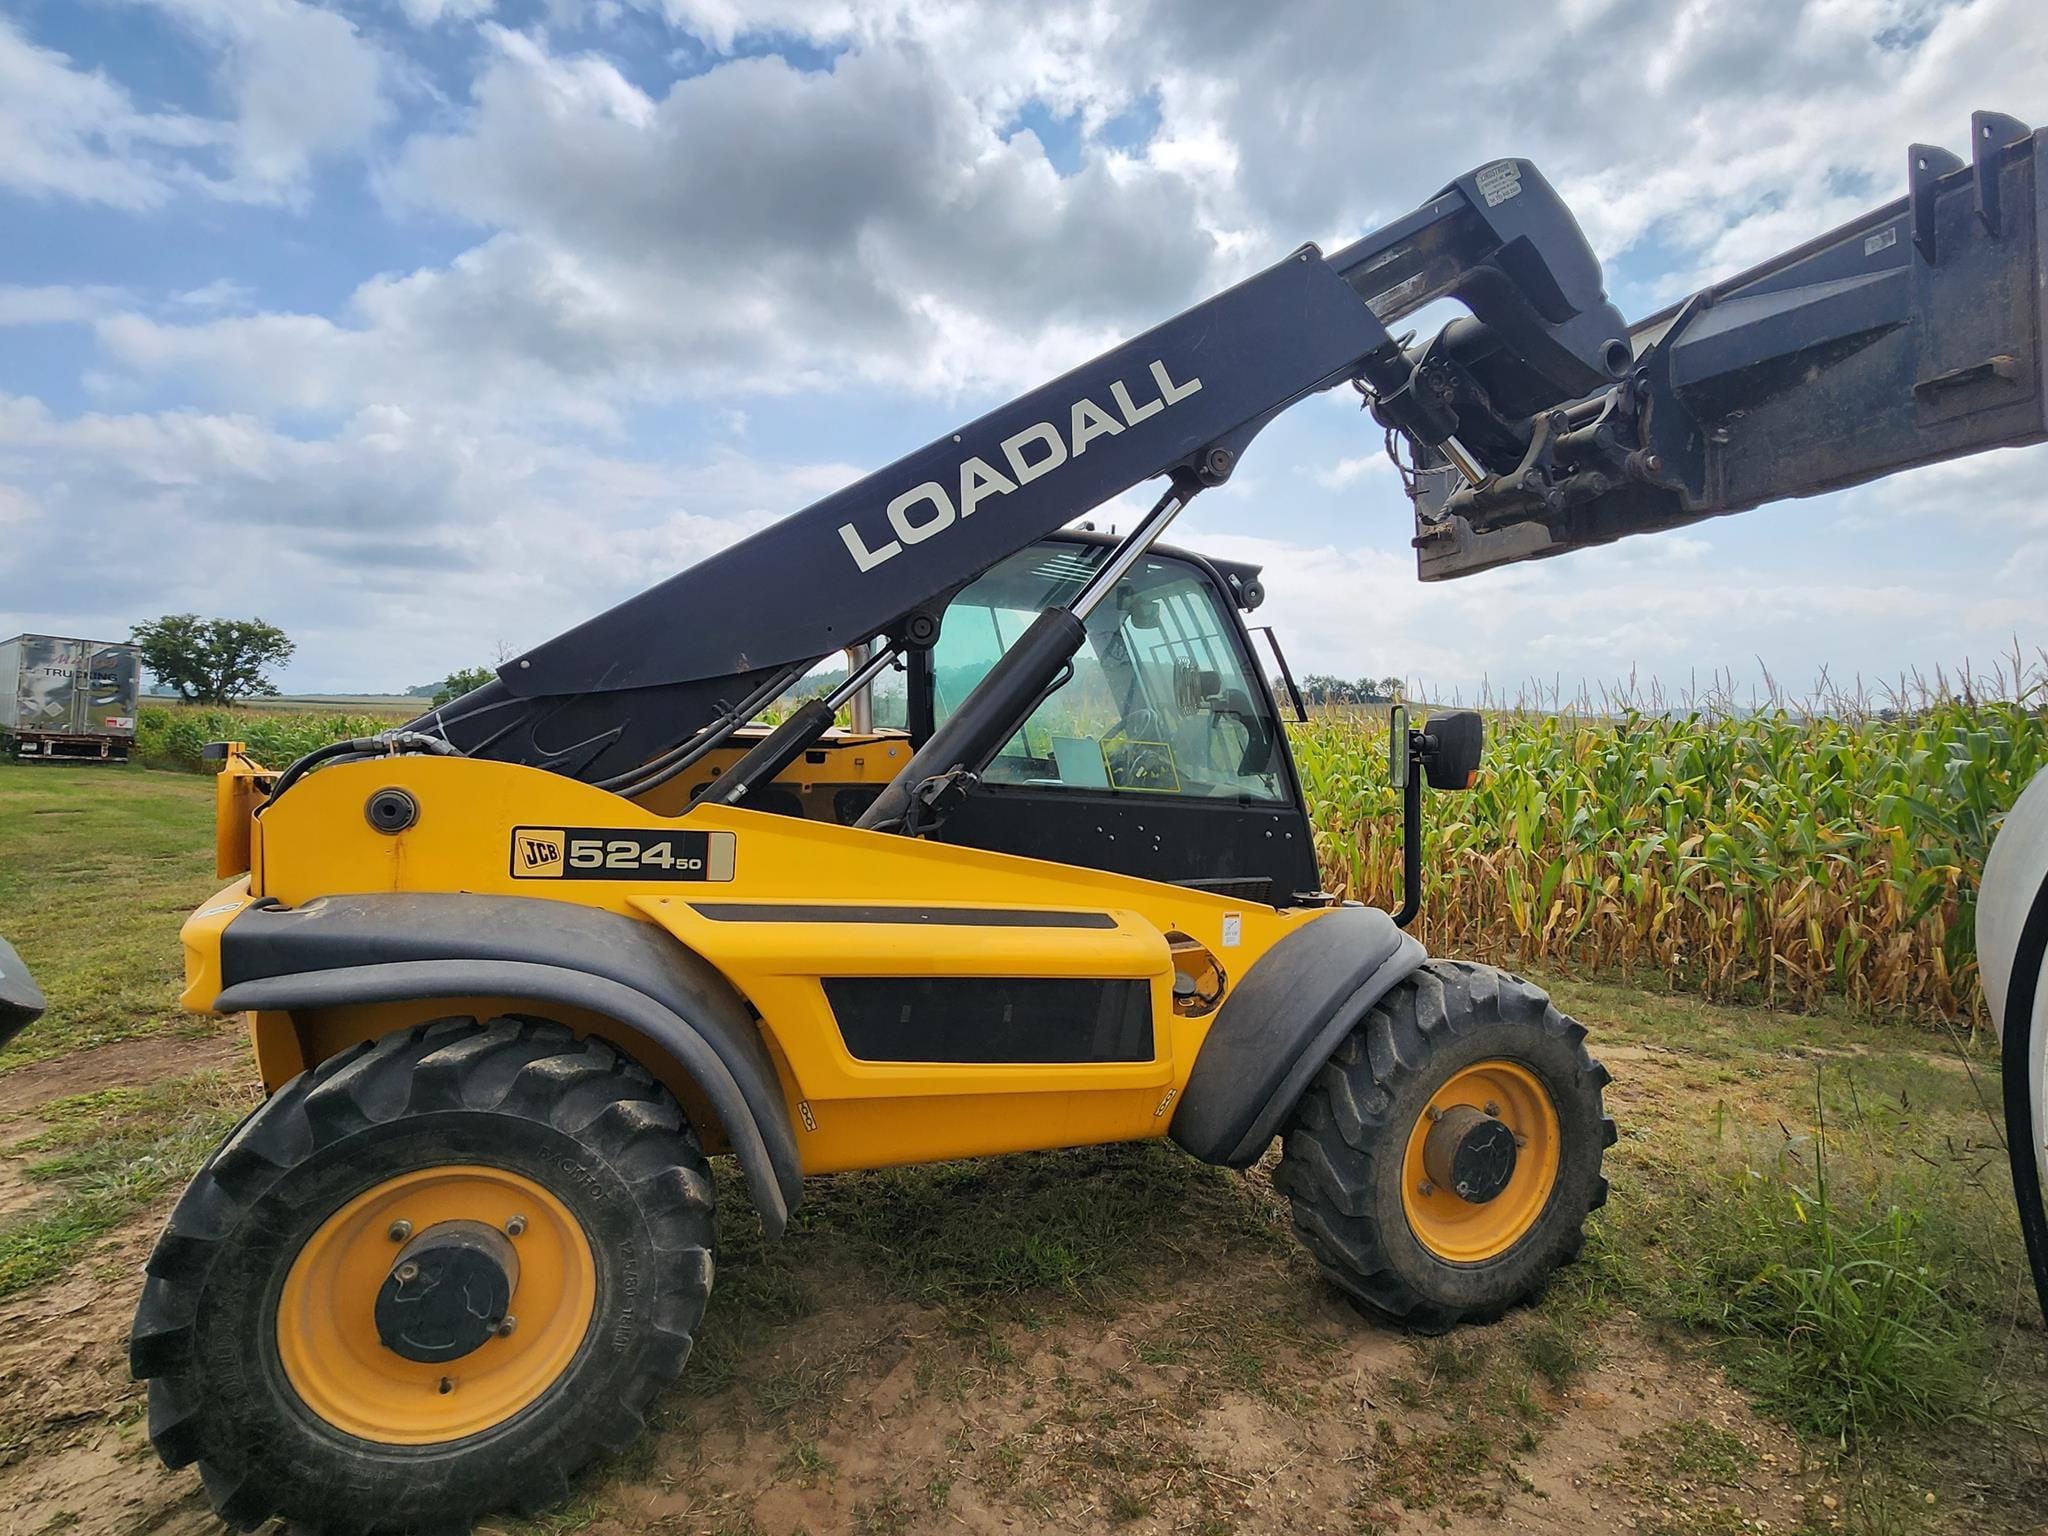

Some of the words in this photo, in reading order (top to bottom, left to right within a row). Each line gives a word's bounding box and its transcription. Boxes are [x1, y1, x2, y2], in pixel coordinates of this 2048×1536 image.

[838, 359, 1203, 573] LOADALL
[525, 840, 559, 867] JCB
[569, 840, 675, 870] 524
[675, 858, 702, 871] 50
